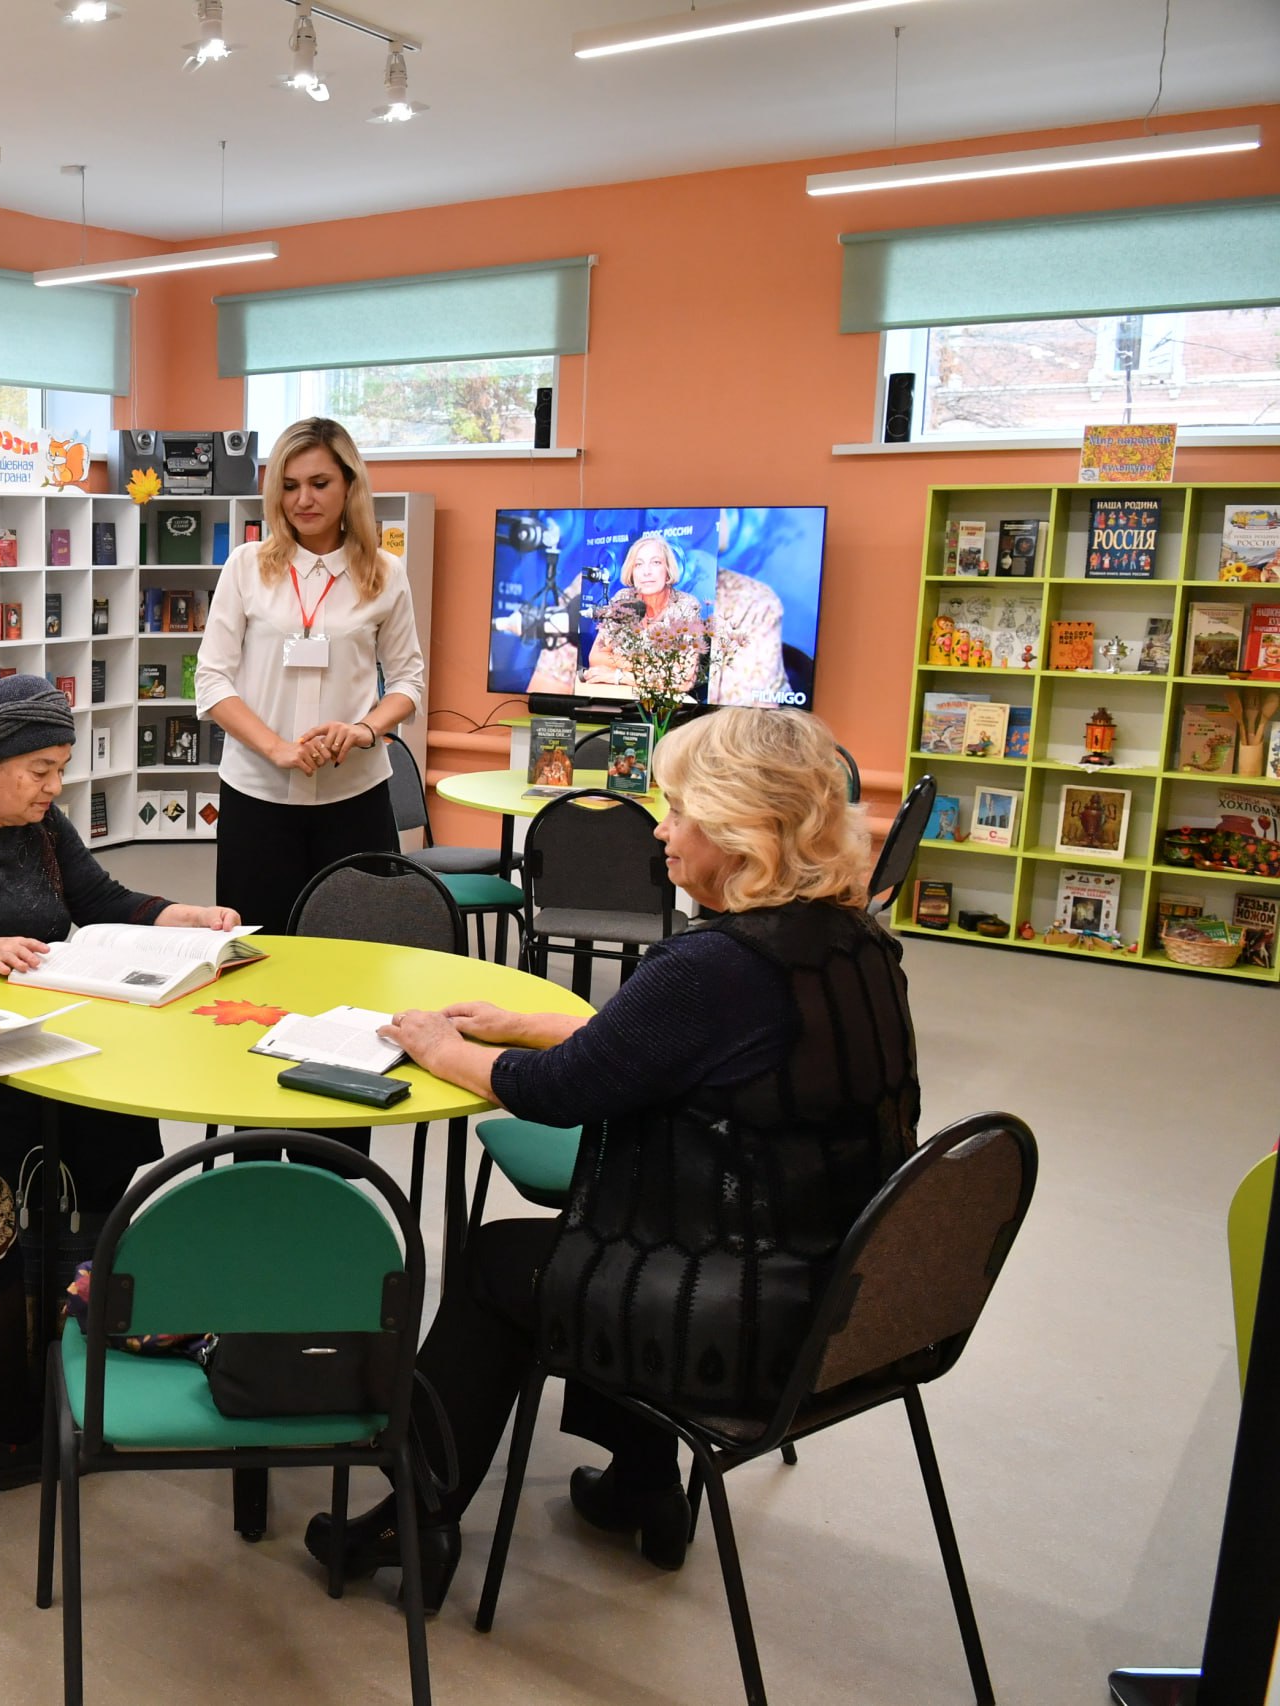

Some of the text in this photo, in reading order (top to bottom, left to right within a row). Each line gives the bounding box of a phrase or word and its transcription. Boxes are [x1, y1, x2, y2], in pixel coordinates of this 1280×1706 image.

[1124, 501, 1158, 510] РОДИНА
[664, 526, 693, 537] РОССИИ
[1092, 529, 1157, 550] РОССИЯ
[751, 690, 807, 705] FILMIGO
[1237, 897, 1277, 913] РЕЗЬБА
[1236, 907, 1275, 925] НОЖОМ
